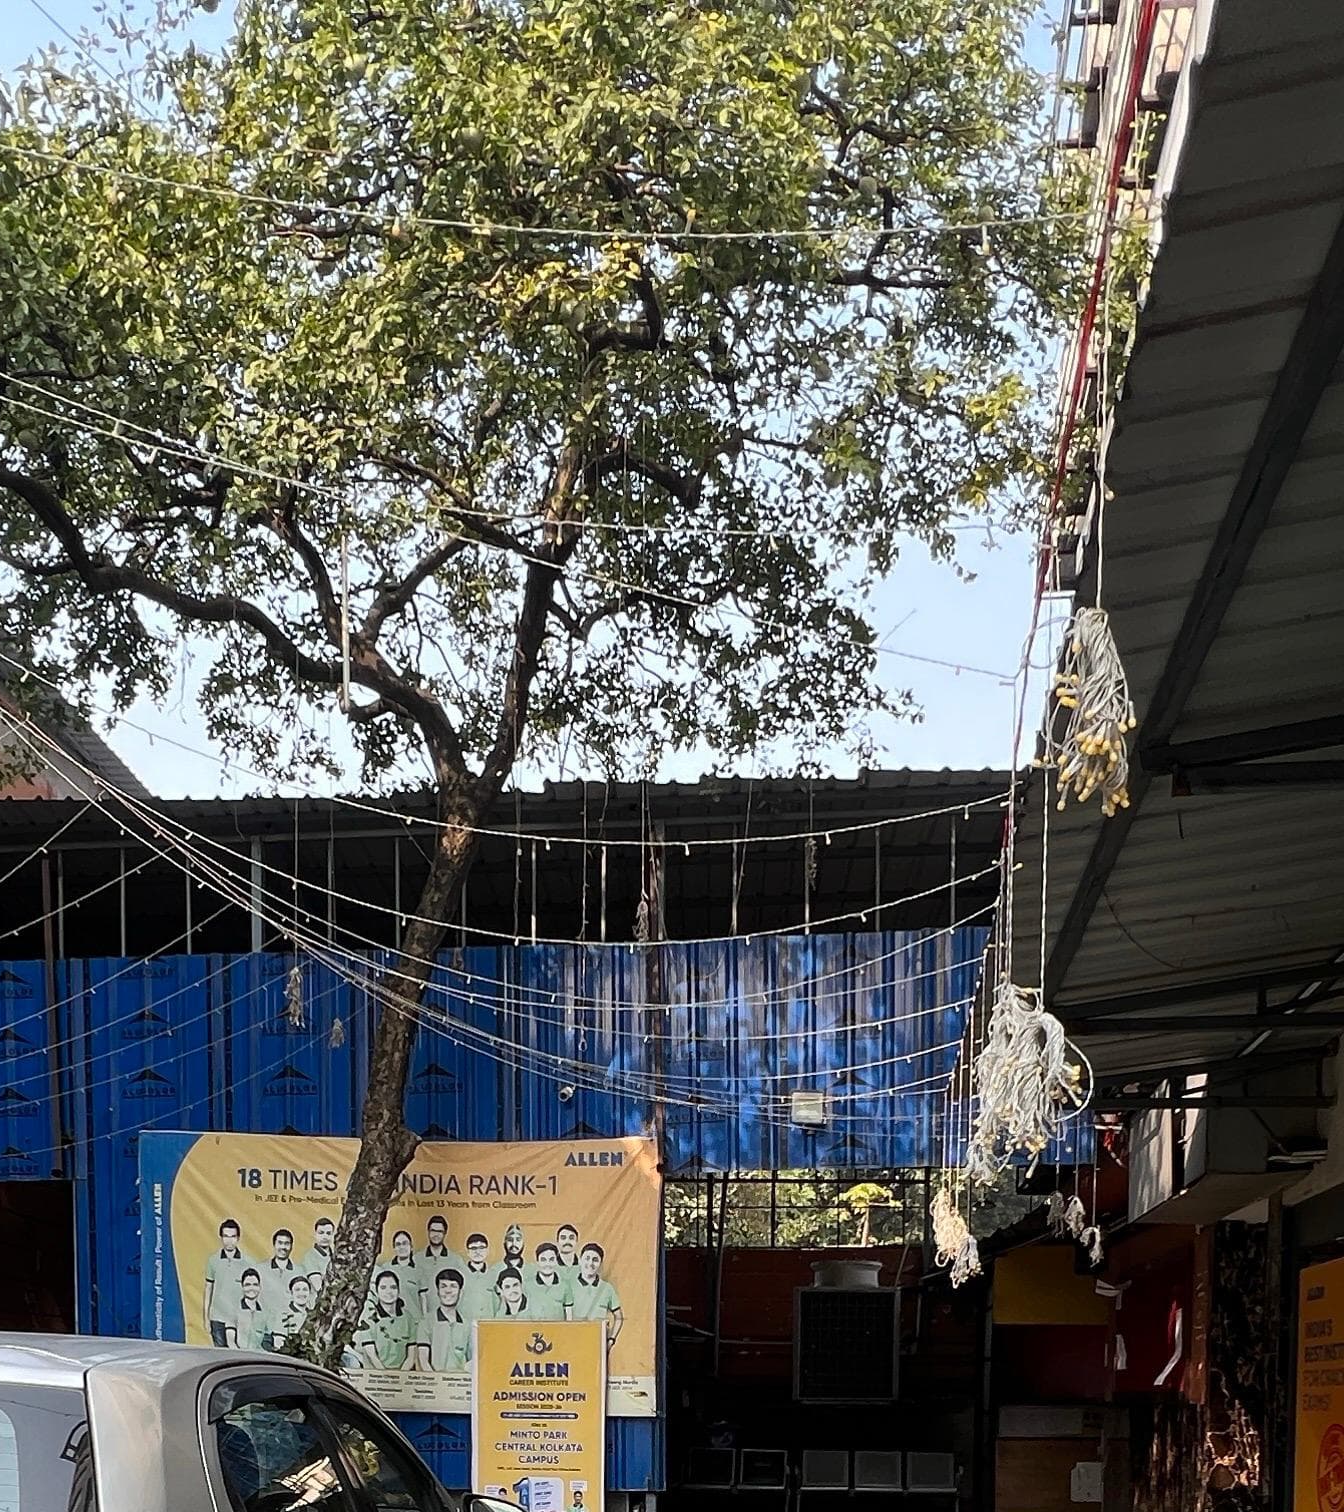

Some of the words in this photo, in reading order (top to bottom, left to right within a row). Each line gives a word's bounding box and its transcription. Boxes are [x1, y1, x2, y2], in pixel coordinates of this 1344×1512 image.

[564, 1152, 624, 1167] ALLEN
[237, 1168, 262, 1190] 18
[268, 1169, 339, 1192] TIMES
[469, 1174, 558, 1196] RANK-1
[511, 1362, 569, 1378] ALLEN
[493, 1392, 554, 1401] ADMISSION
[556, 1392, 586, 1401] OPEN
[510, 1431, 541, 1440] MINTO
[543, 1431, 567, 1439] PARK
[495, 1443, 536, 1451] CENTRAL
[540, 1443, 583, 1452] KOLKATA
[518, 1456, 559, 1464] CAMPUS
